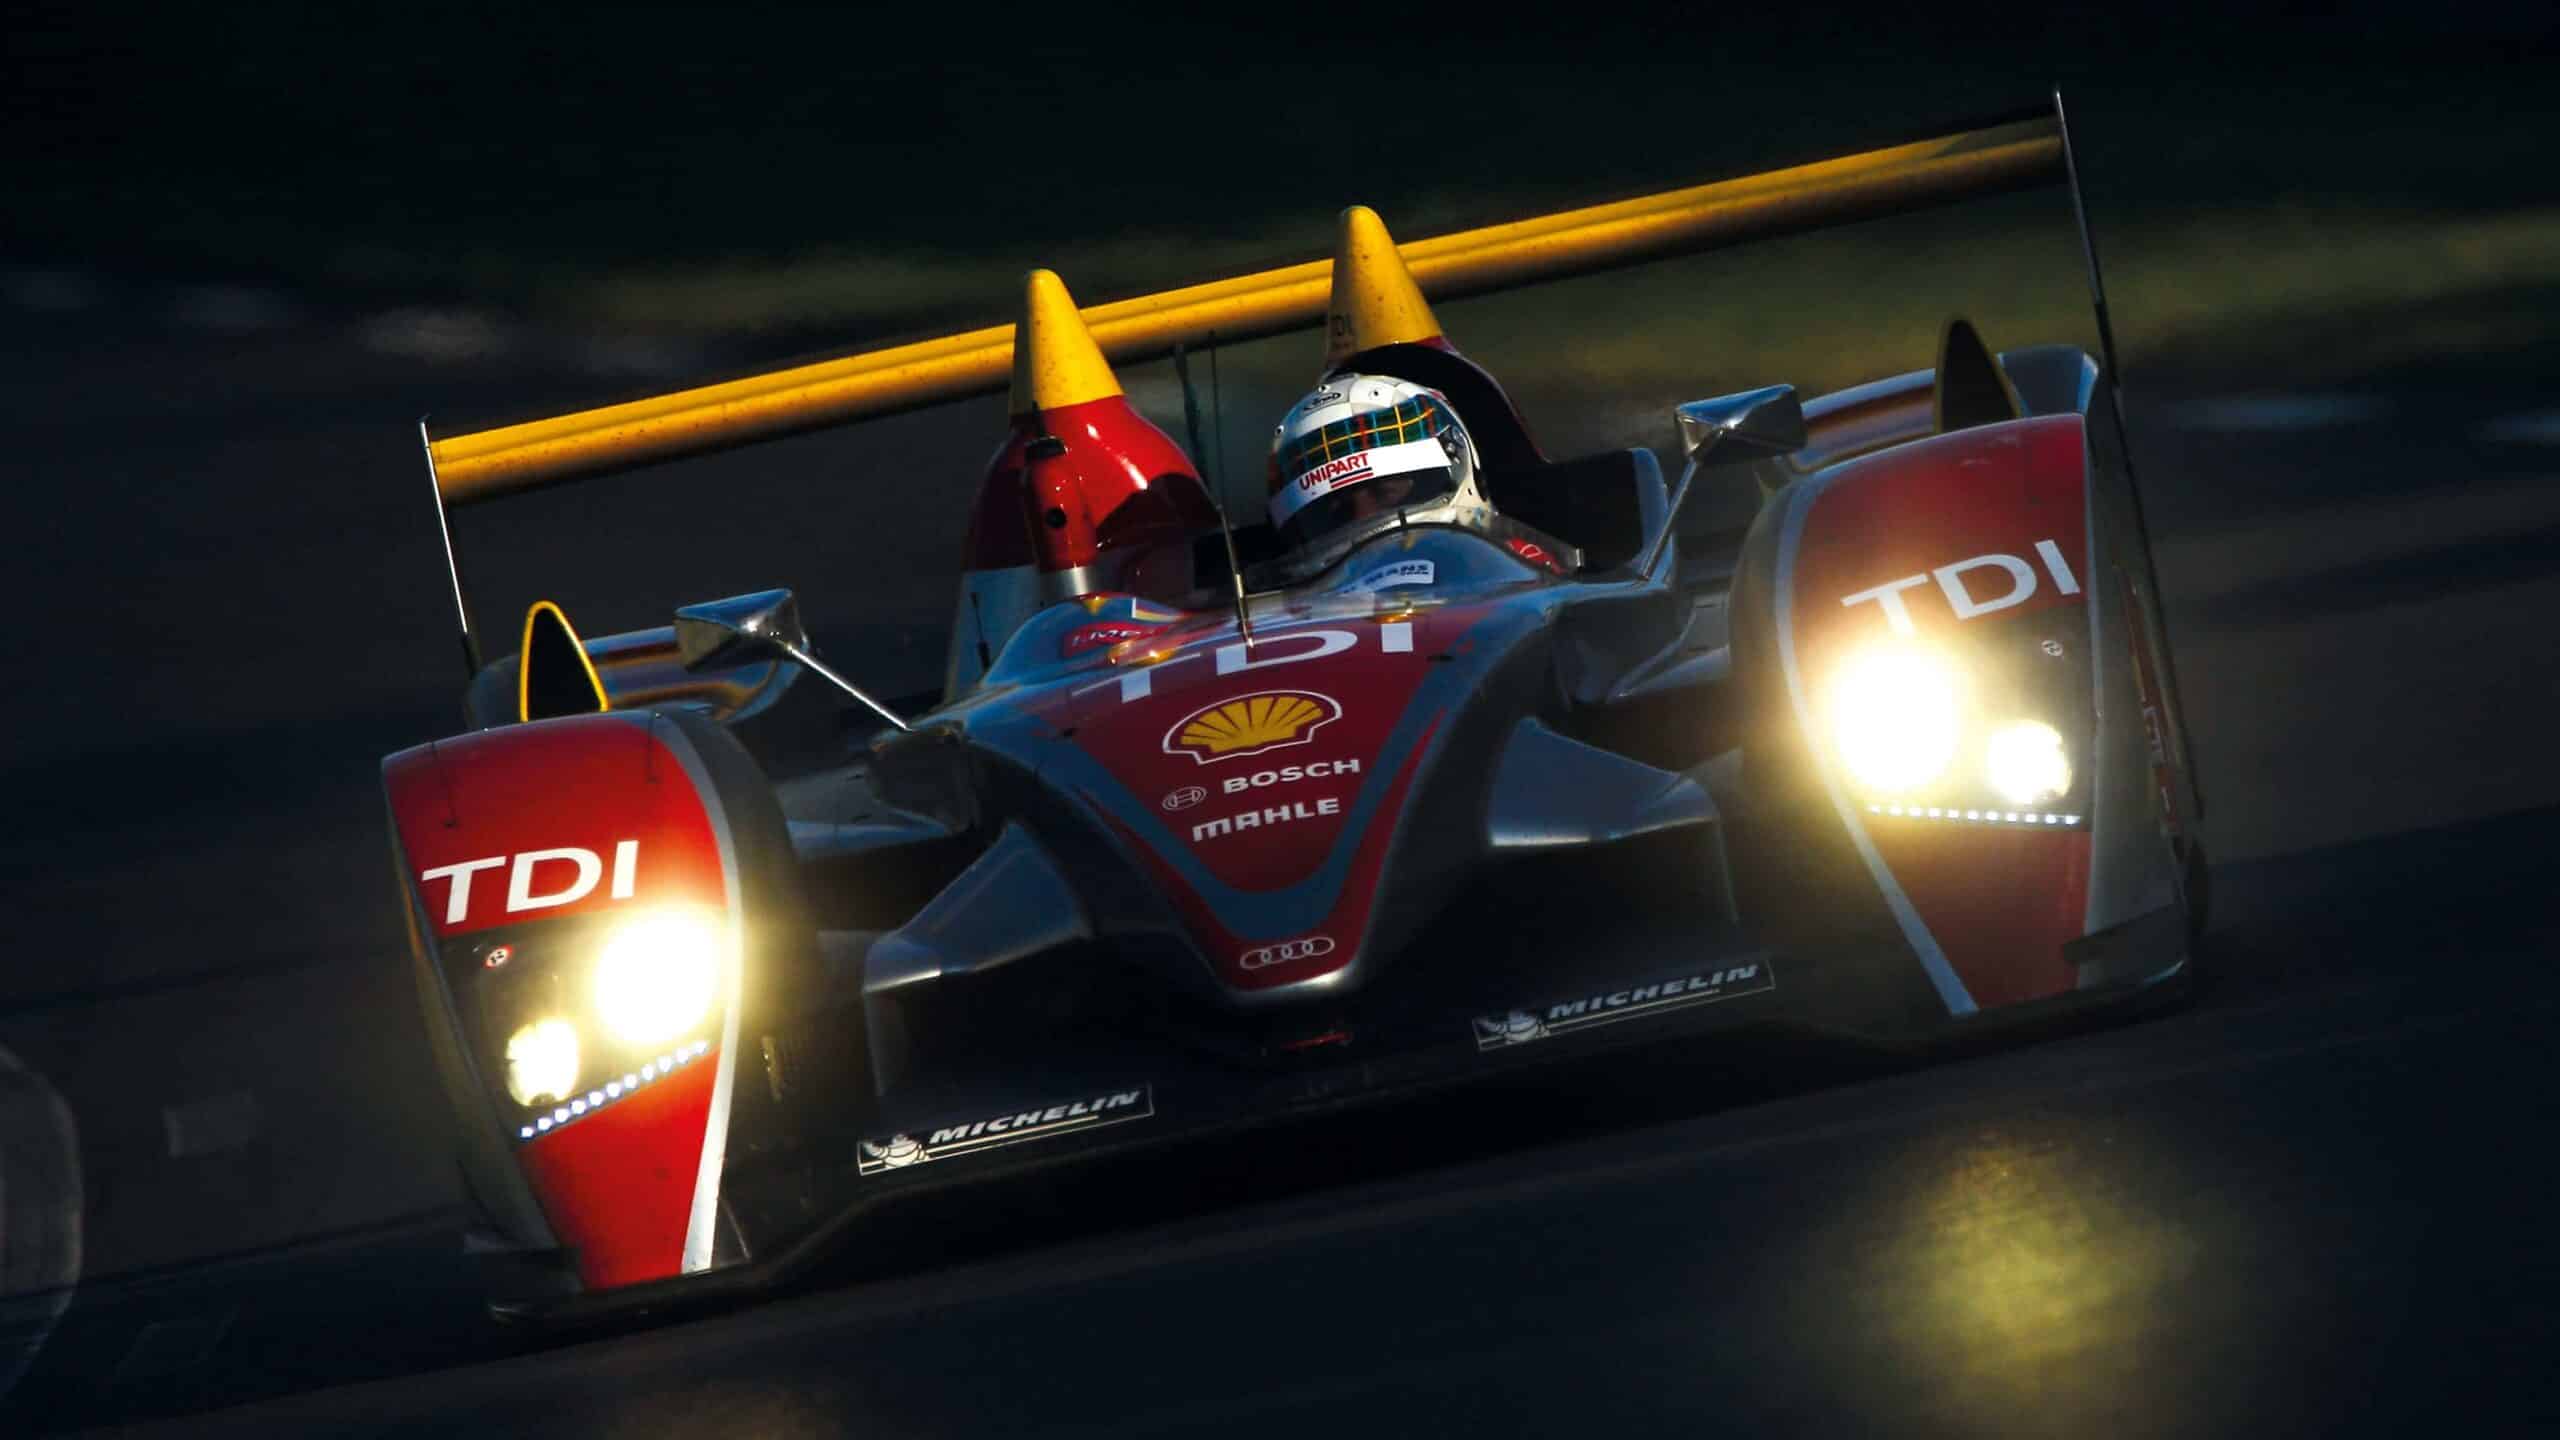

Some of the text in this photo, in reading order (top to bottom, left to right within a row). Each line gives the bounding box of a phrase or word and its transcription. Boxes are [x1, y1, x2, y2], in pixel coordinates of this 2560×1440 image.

[1300, 453, 1368, 490] UNIPART
[1840, 539, 2081, 636] TDI
[1071, 620, 1415, 704] TDI
[1223, 759, 1361, 795] BOSCH
[1192, 797, 1341, 842] MAHLE
[421, 840, 640, 925] TDI
[1551, 963, 1759, 1020] MICHELIN
[928, 1089, 1141, 1145] MICHELIN
